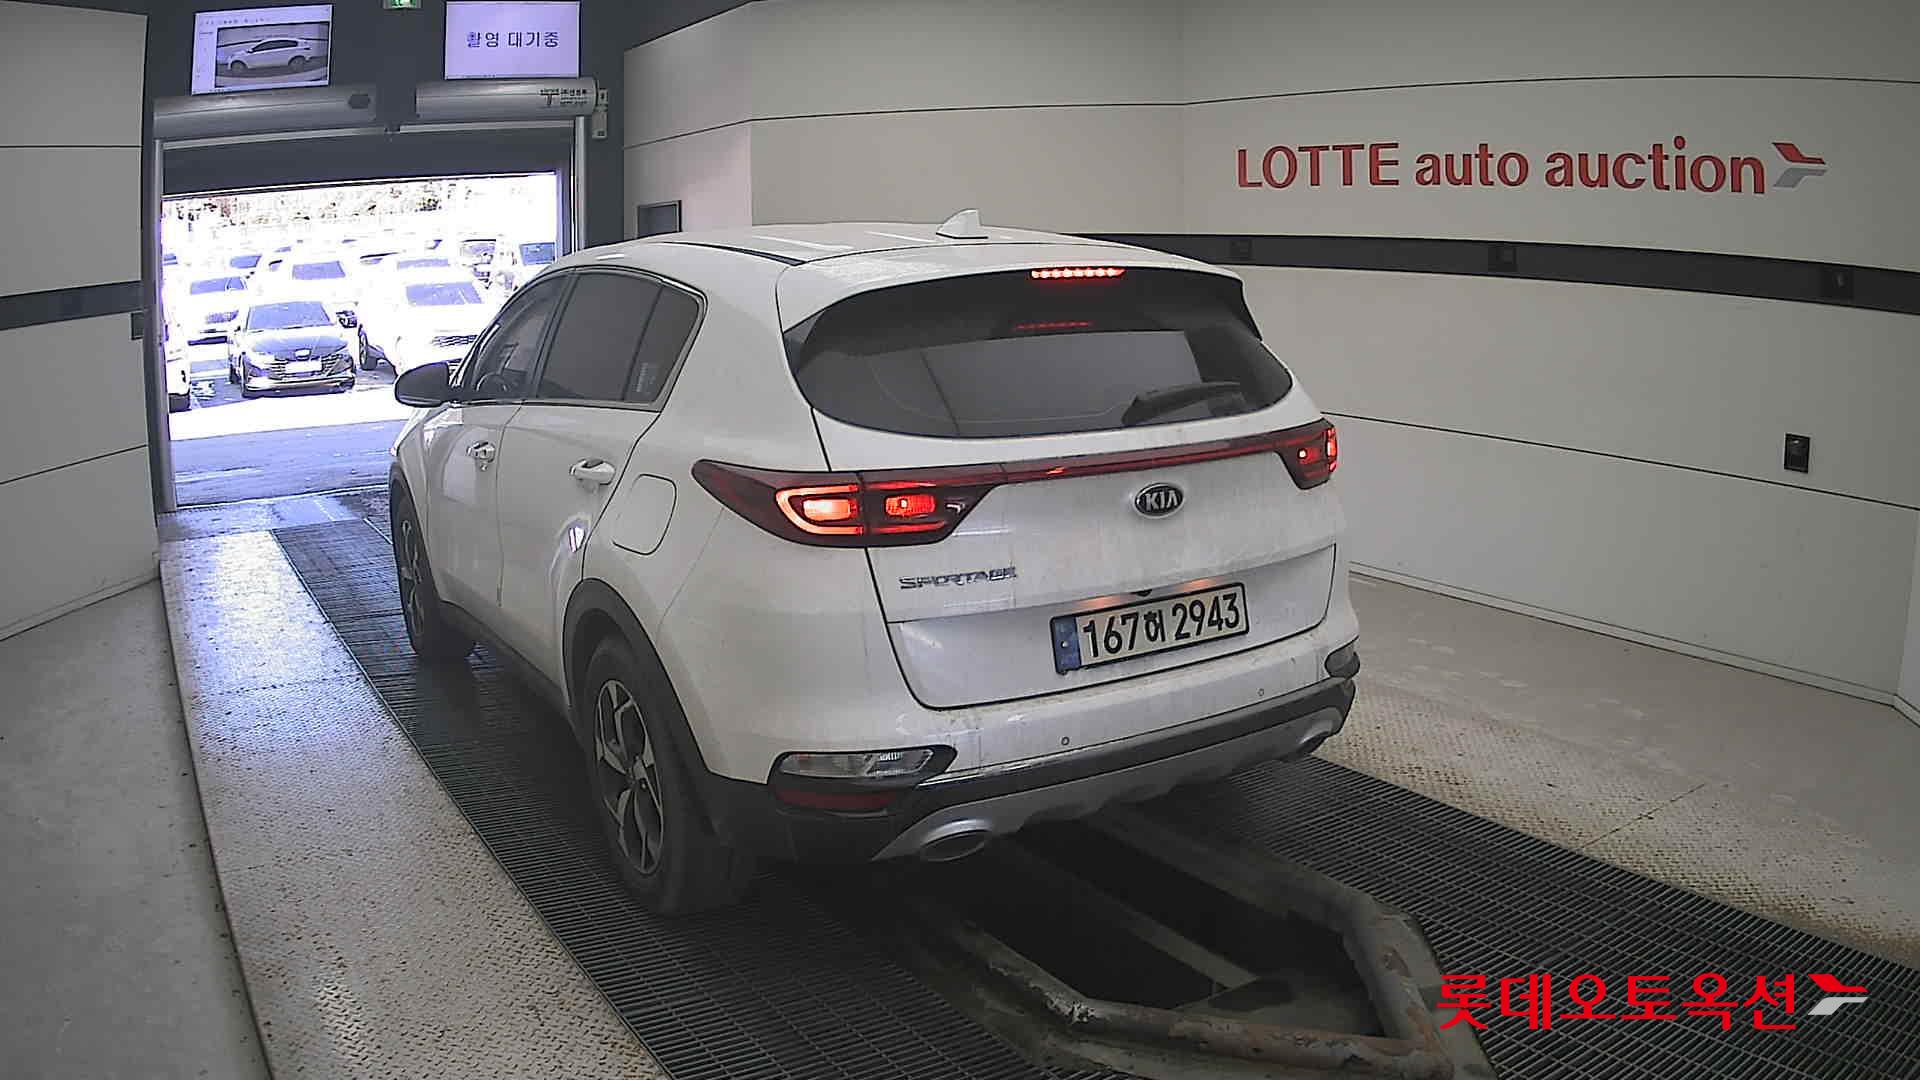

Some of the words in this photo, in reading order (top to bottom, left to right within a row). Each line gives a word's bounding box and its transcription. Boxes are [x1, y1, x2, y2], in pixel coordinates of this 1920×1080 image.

[508, 31, 559, 48] 대기중
[1237, 143, 1399, 188] LOTTE
[1415, 143, 1529, 186] auto
[1545, 135, 1765, 194] auction
[1145, 490, 1178, 511] KIA
[1172, 593, 1240, 641] 2943
